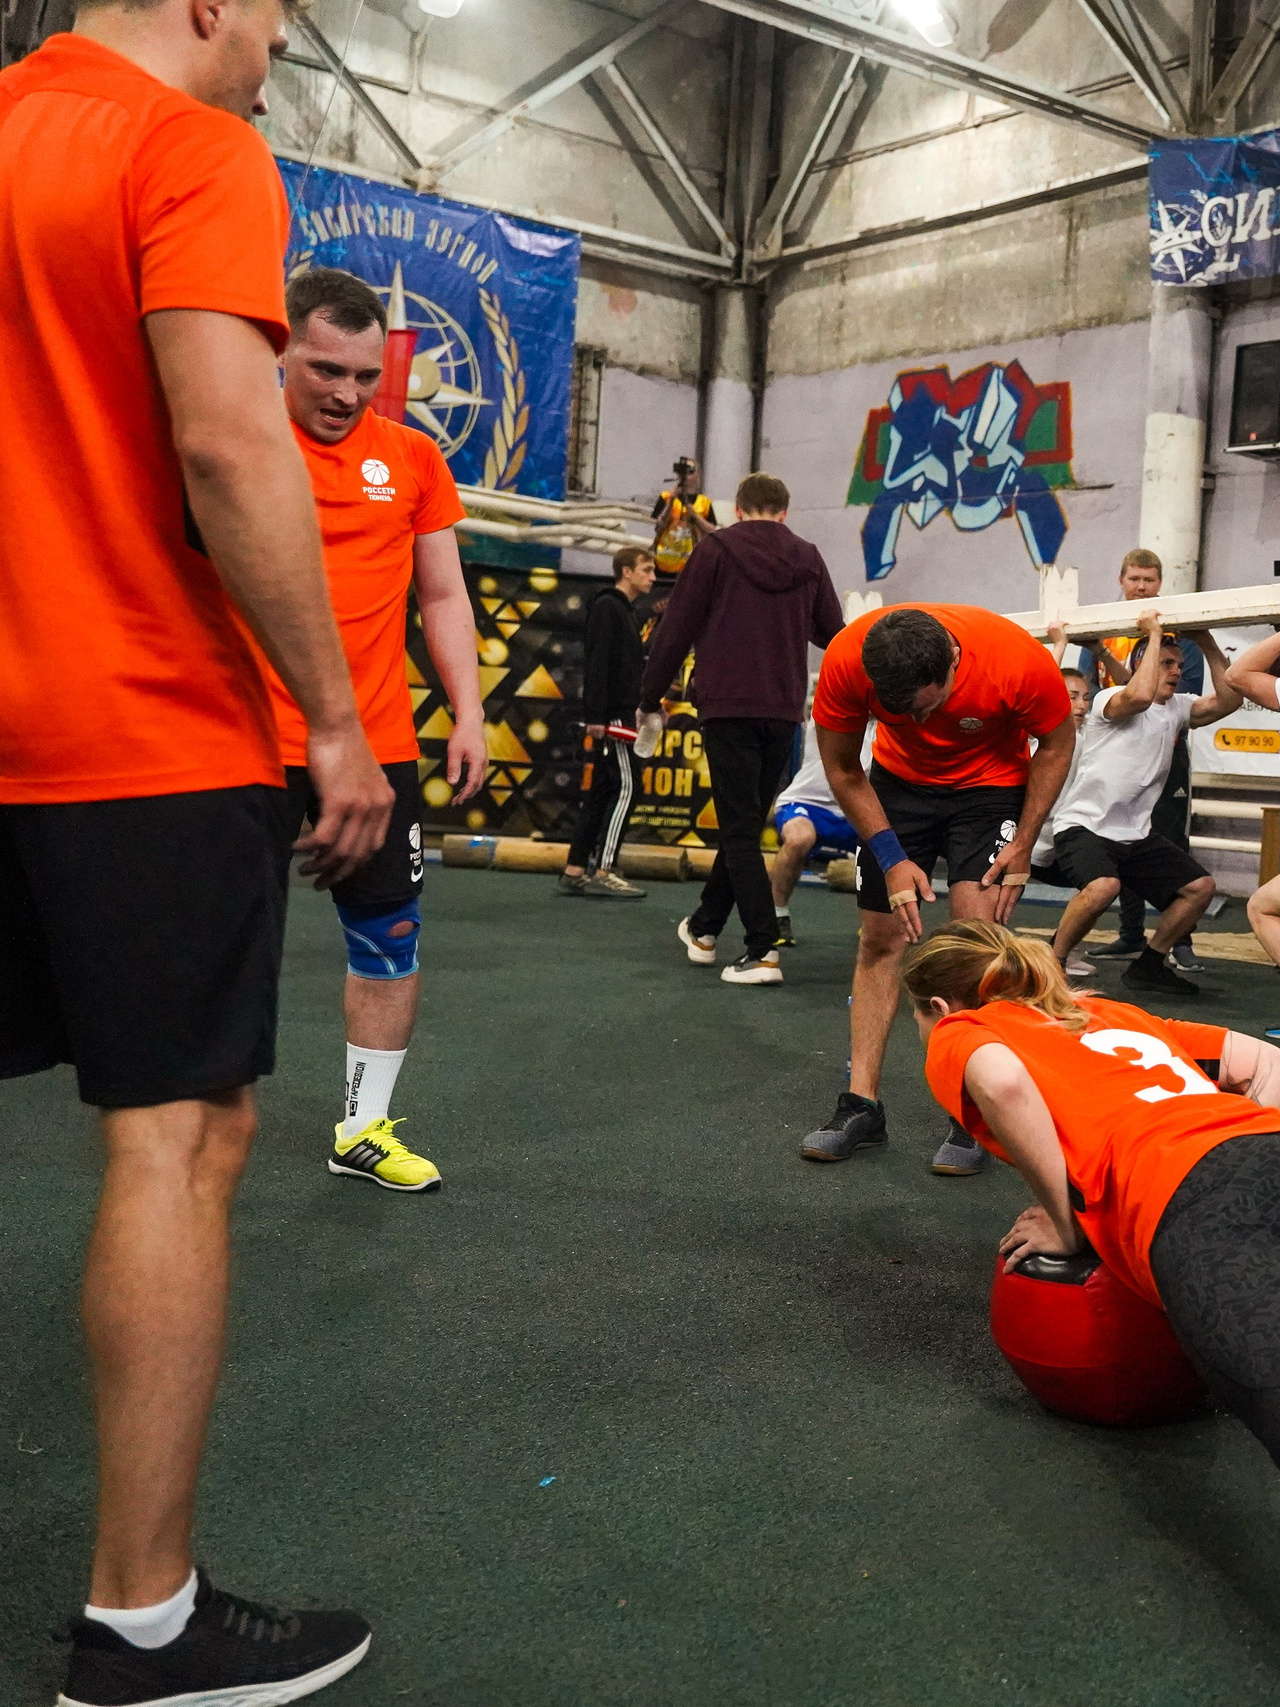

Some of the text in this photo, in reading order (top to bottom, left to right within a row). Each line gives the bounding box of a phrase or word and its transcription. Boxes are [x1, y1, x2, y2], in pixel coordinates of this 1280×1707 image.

[362, 486, 396, 496] РОССЕТИ
[1235, 736, 1274, 747] 97 90 90
[1080, 1028, 1219, 1104] 3
